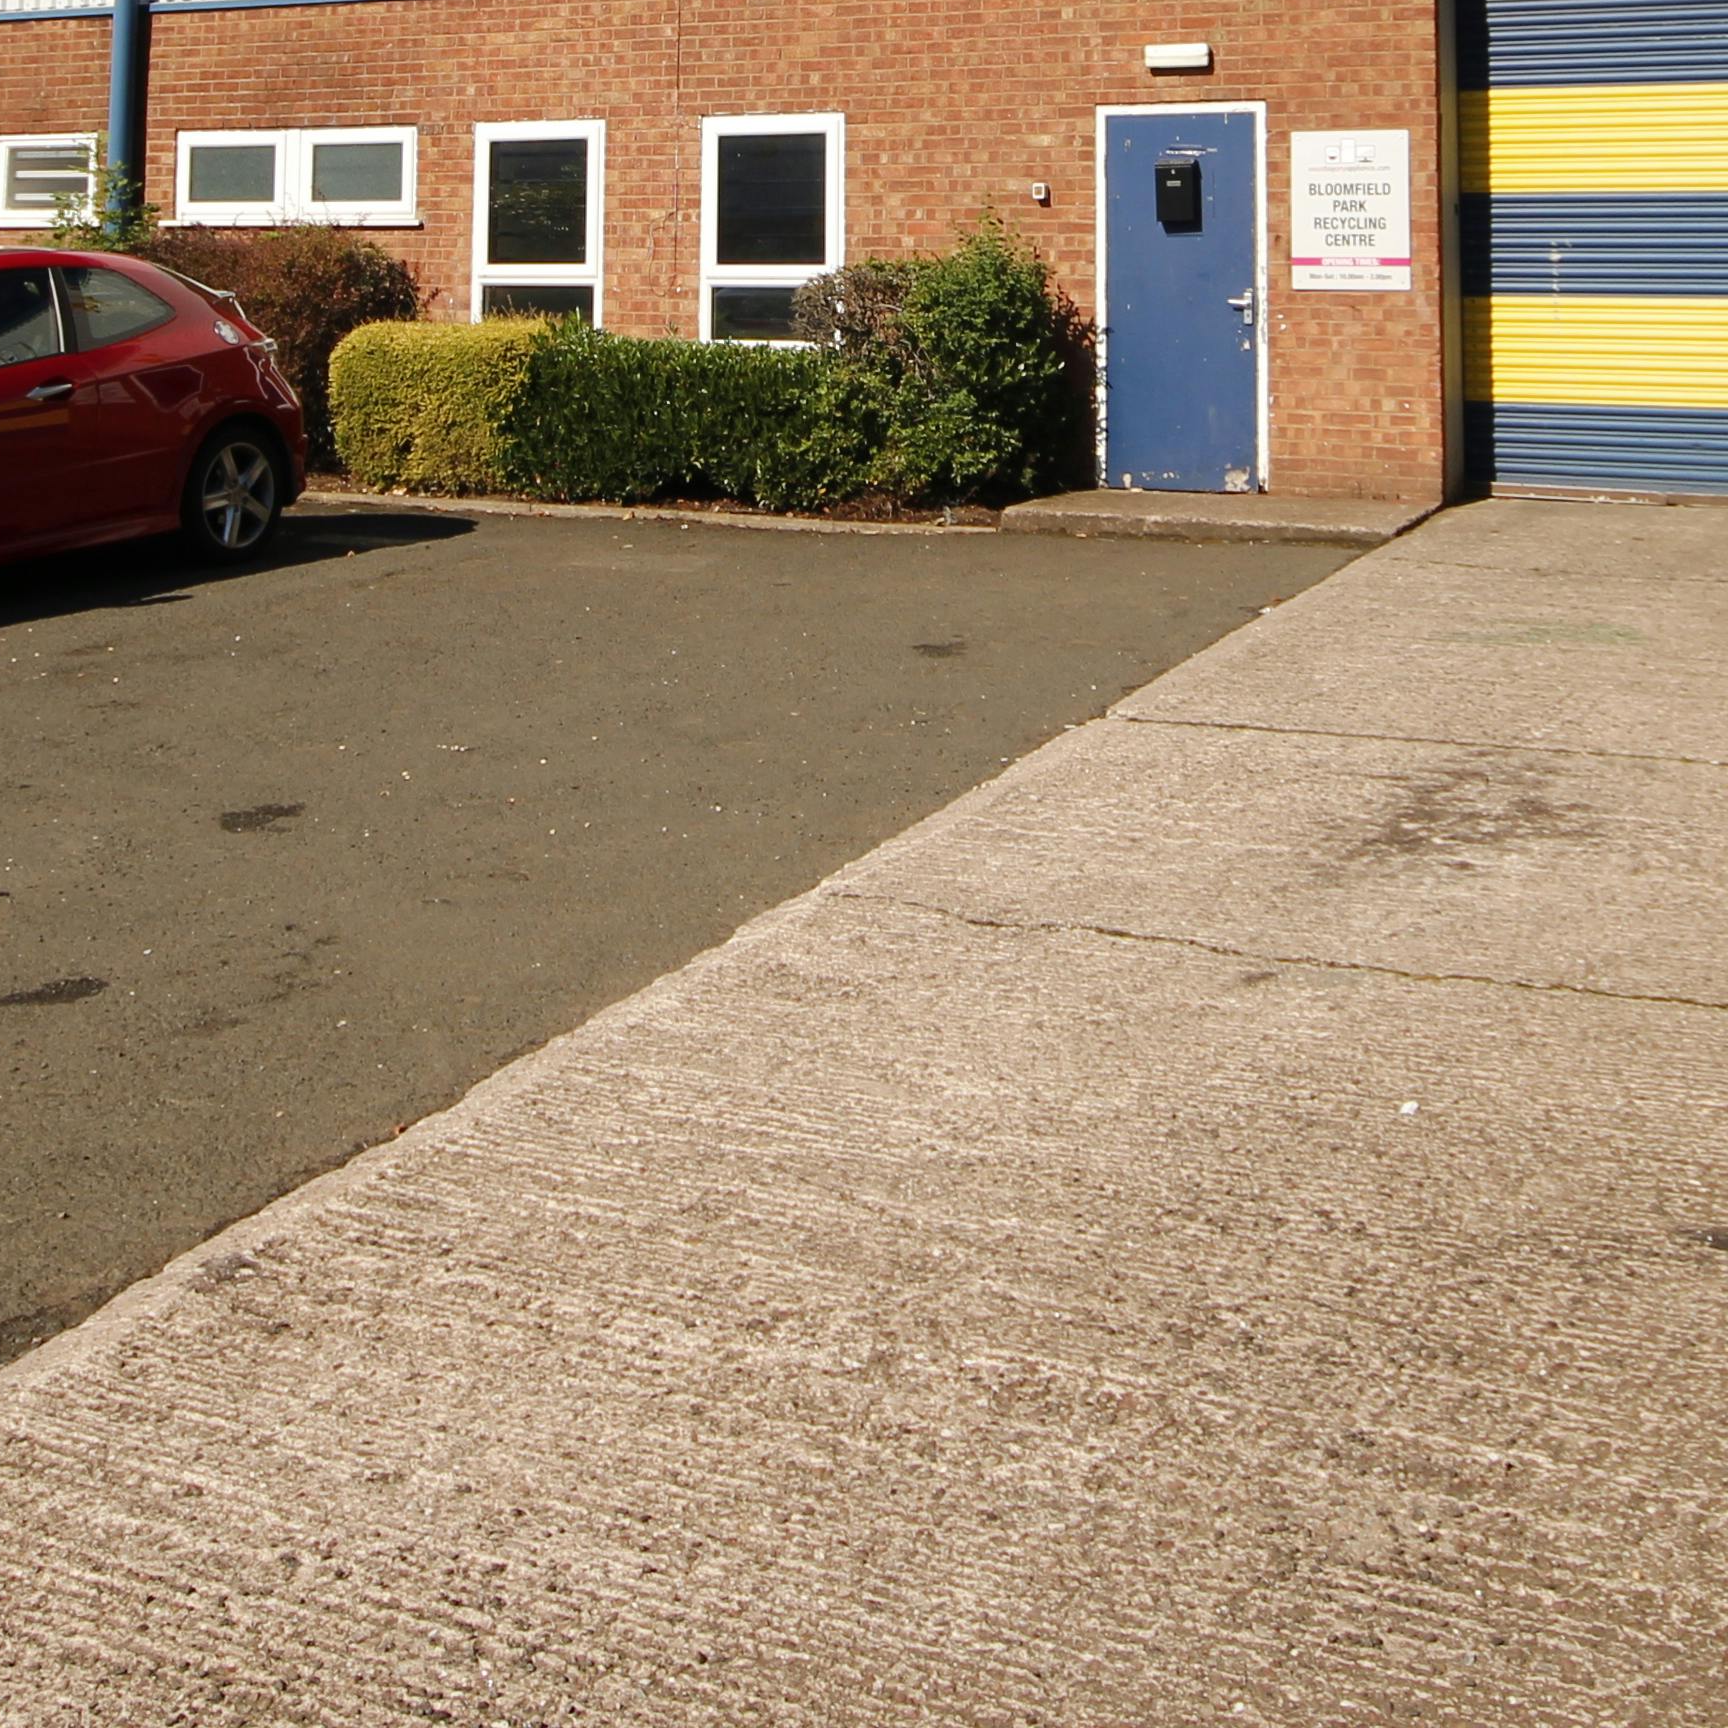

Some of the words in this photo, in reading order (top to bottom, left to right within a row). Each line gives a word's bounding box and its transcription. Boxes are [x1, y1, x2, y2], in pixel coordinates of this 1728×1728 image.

[1308, 183, 1392, 196] BLOOMFIELD
[1333, 200, 1367, 212] PARK
[1314, 217, 1387, 230] RECYCLING
[1325, 234, 1376, 247] CENTRE
